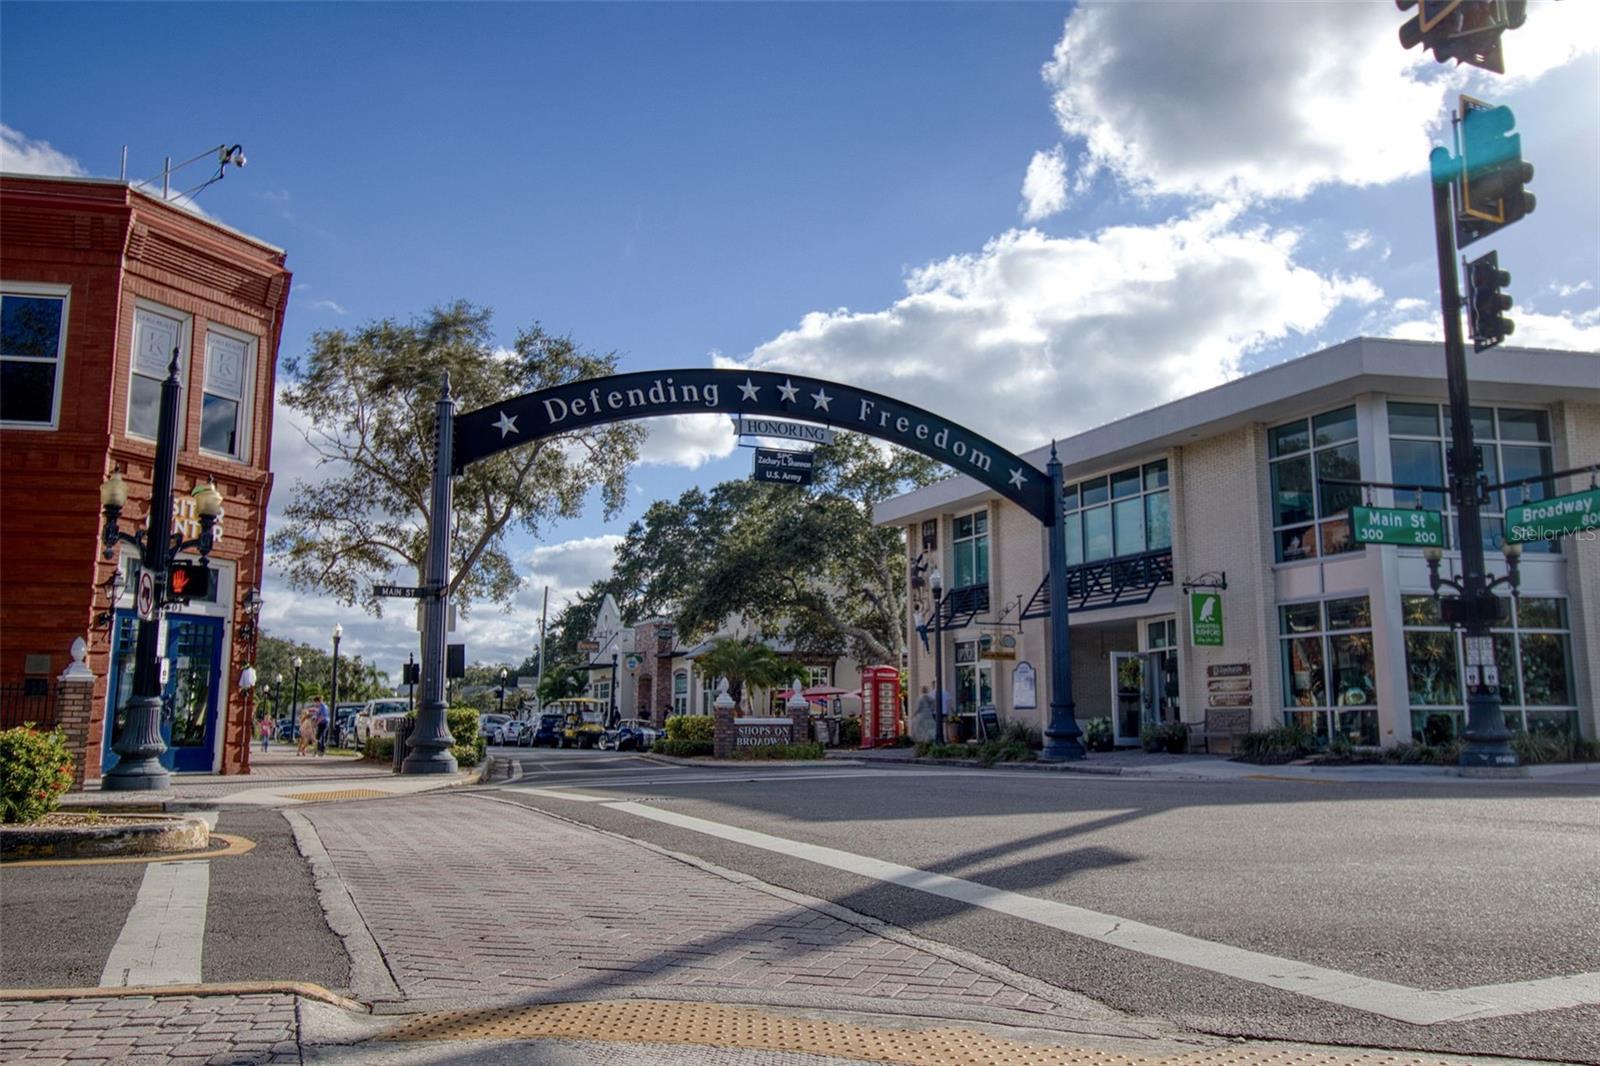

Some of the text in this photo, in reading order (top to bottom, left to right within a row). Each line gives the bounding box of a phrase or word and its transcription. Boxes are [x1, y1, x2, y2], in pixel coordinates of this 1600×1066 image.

[542, 378, 992, 472] Defending Freedom
[747, 421, 824, 440] HONORING
[766, 471, 802, 483] U.S. Army
[1522, 497, 1593, 523] Broadway
[1369, 511, 1426, 529] Main St
[1582, 512, 1600, 526] 80
[1361, 530, 1437, 543] 300 200
[382, 587, 415, 597] MAIN ST
[738, 726, 790, 735] SHOPS ON
